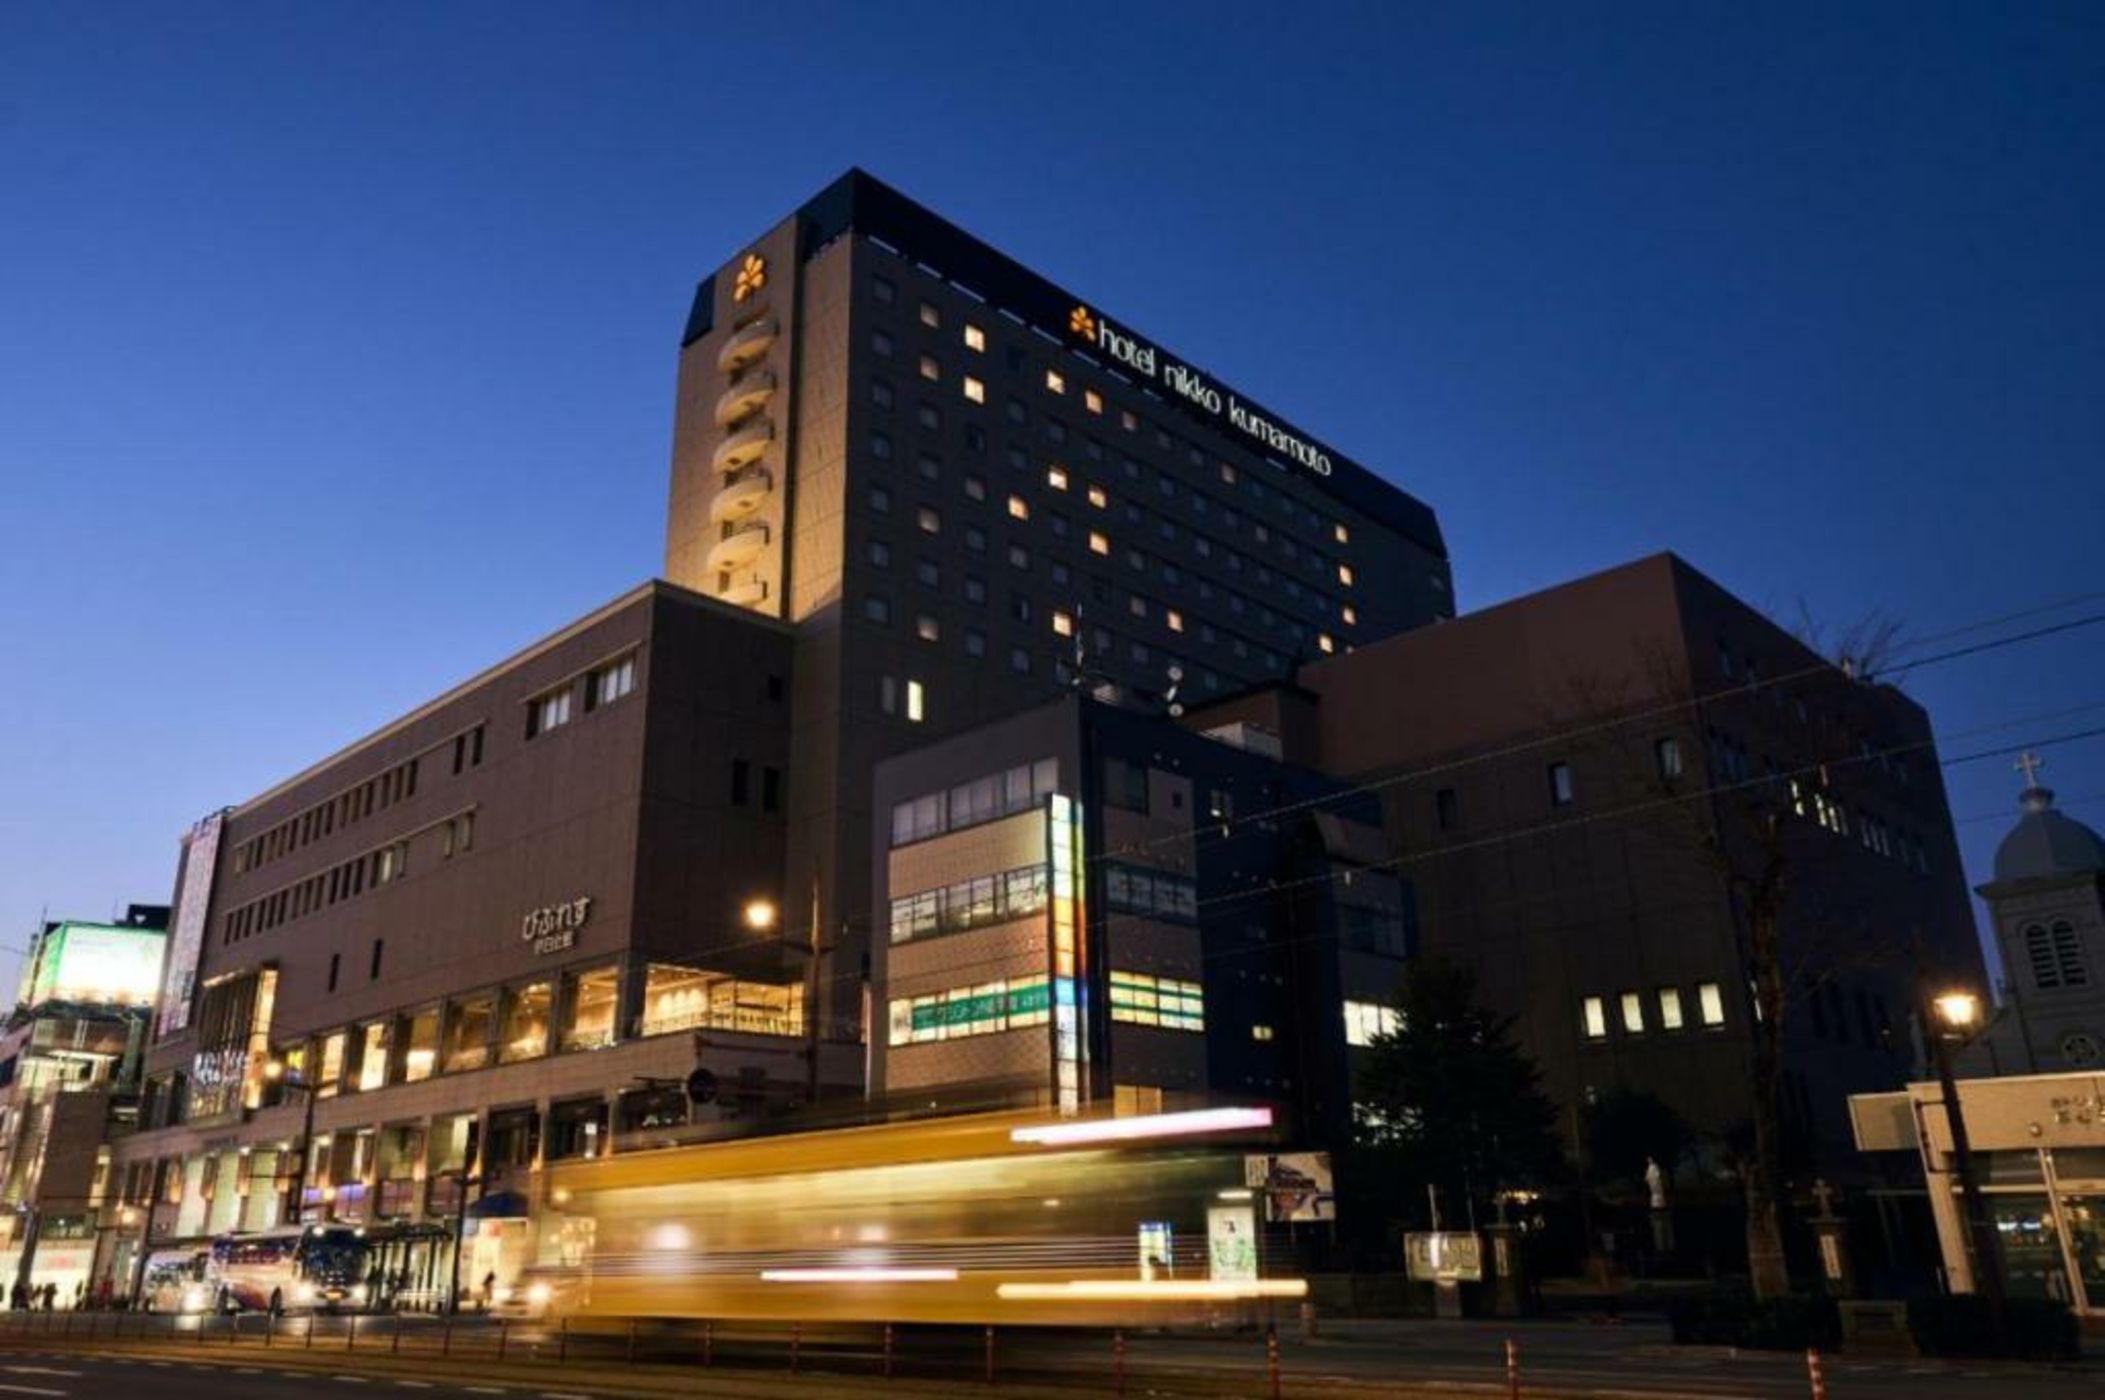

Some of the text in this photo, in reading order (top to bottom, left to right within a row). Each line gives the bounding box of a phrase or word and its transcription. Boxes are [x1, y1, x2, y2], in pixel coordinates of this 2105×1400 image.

[1100, 319, 1332, 476] hotel nikko kumamoto
